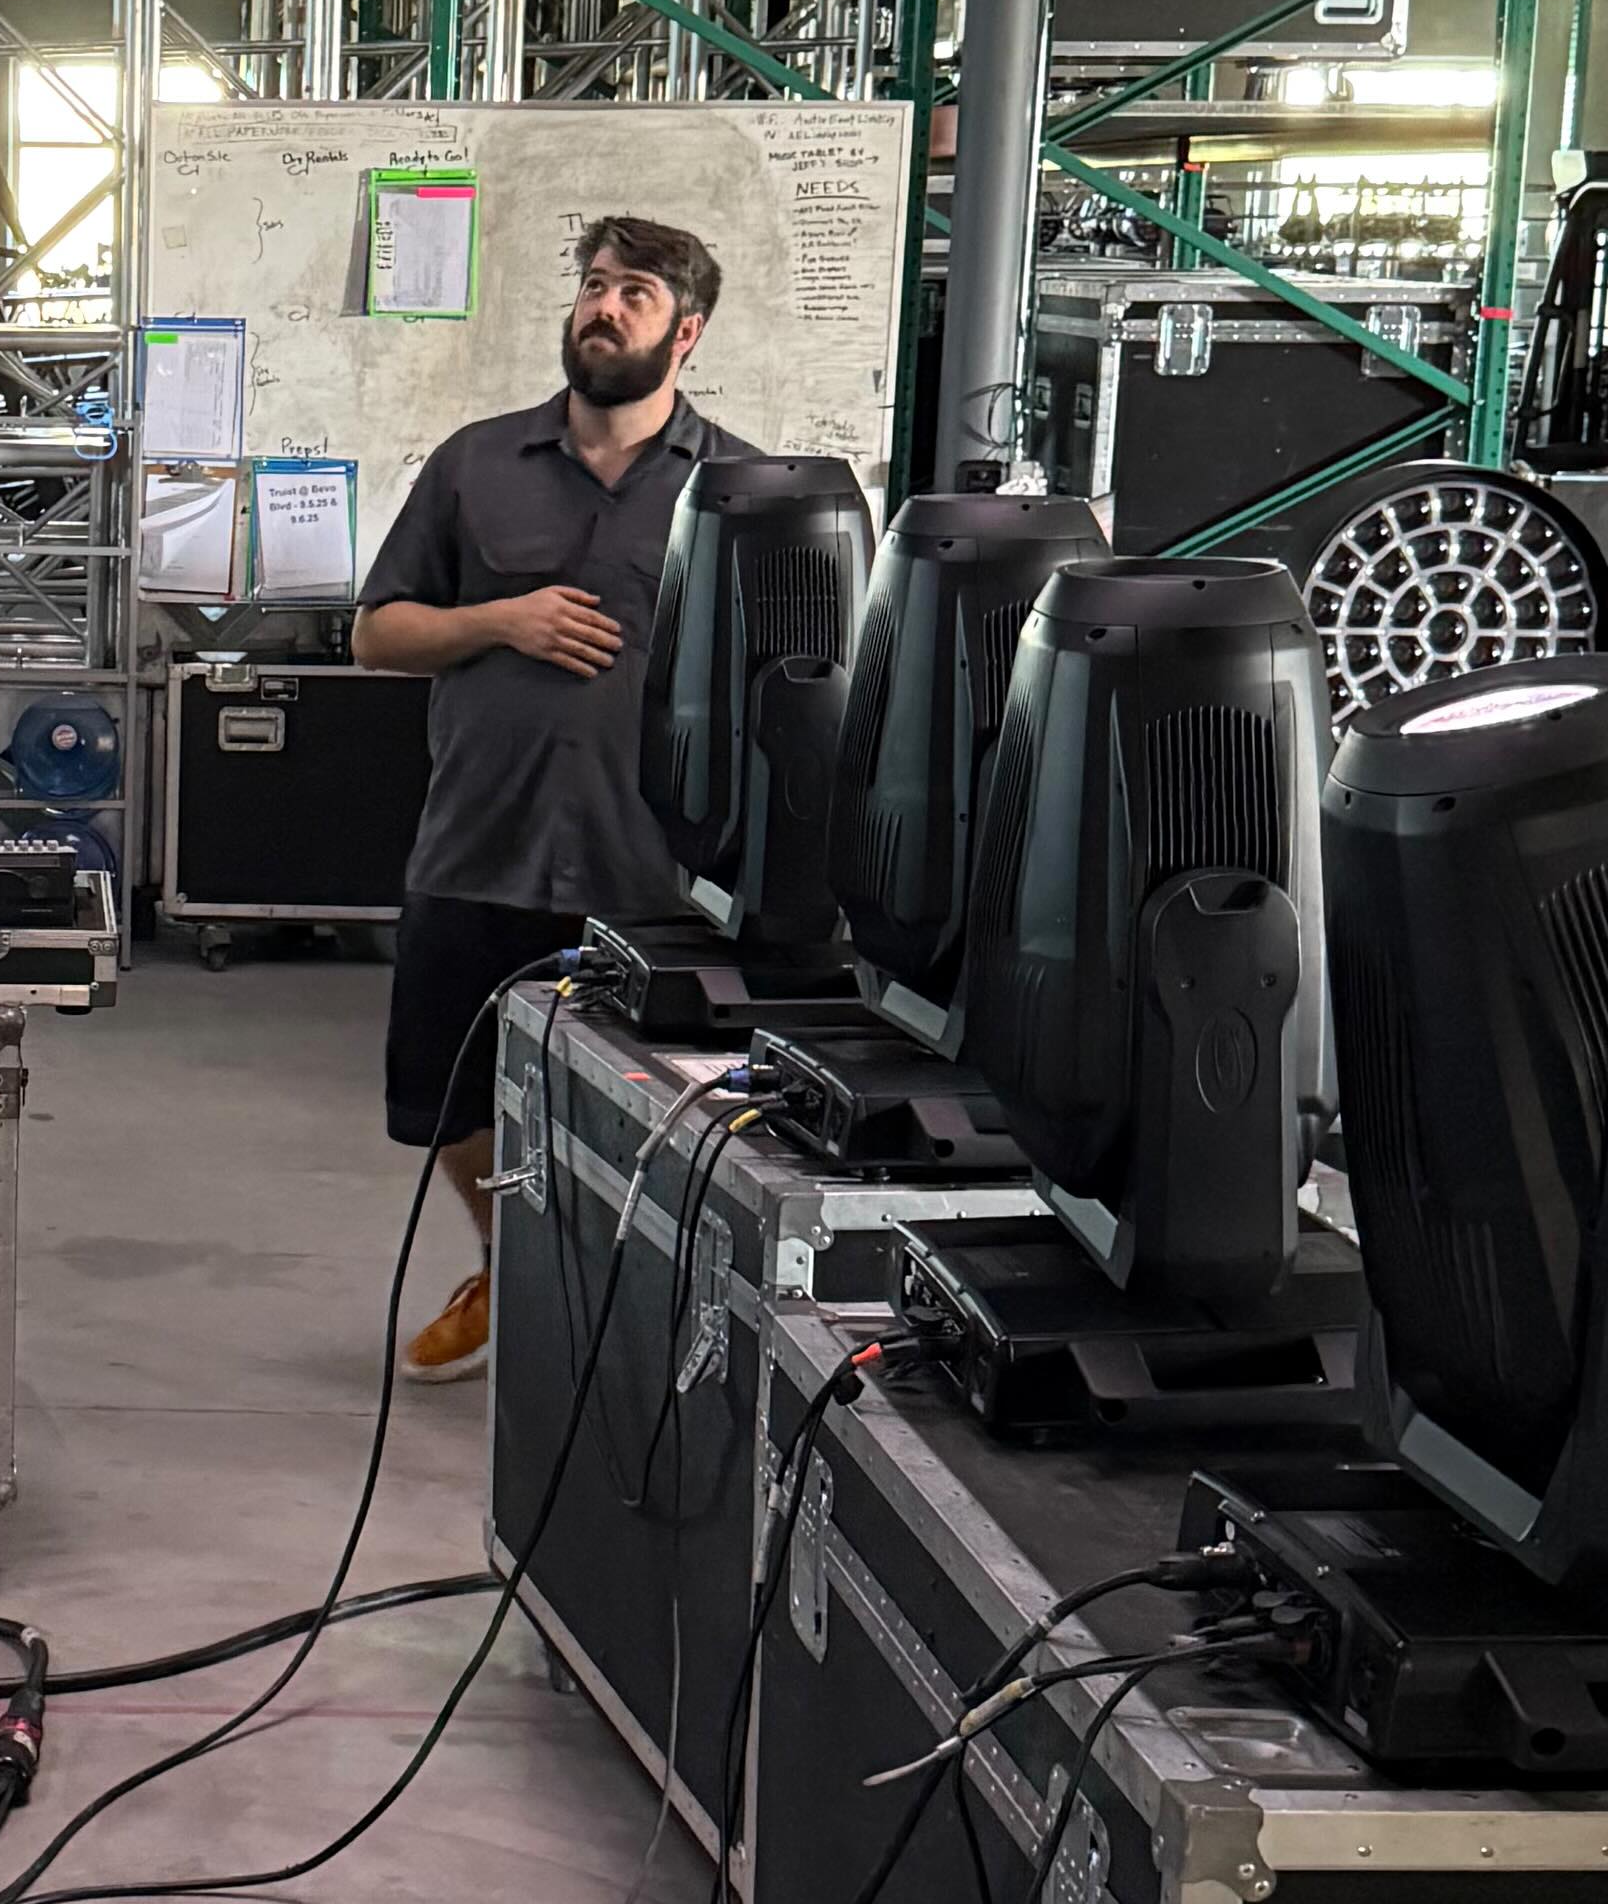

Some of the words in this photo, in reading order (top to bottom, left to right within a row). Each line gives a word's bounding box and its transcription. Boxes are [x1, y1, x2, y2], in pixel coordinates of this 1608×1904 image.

[389, 149, 425, 166] Ready
[795, 180, 861, 197] NEEDS
[281, 436, 328, 458] Preps!
